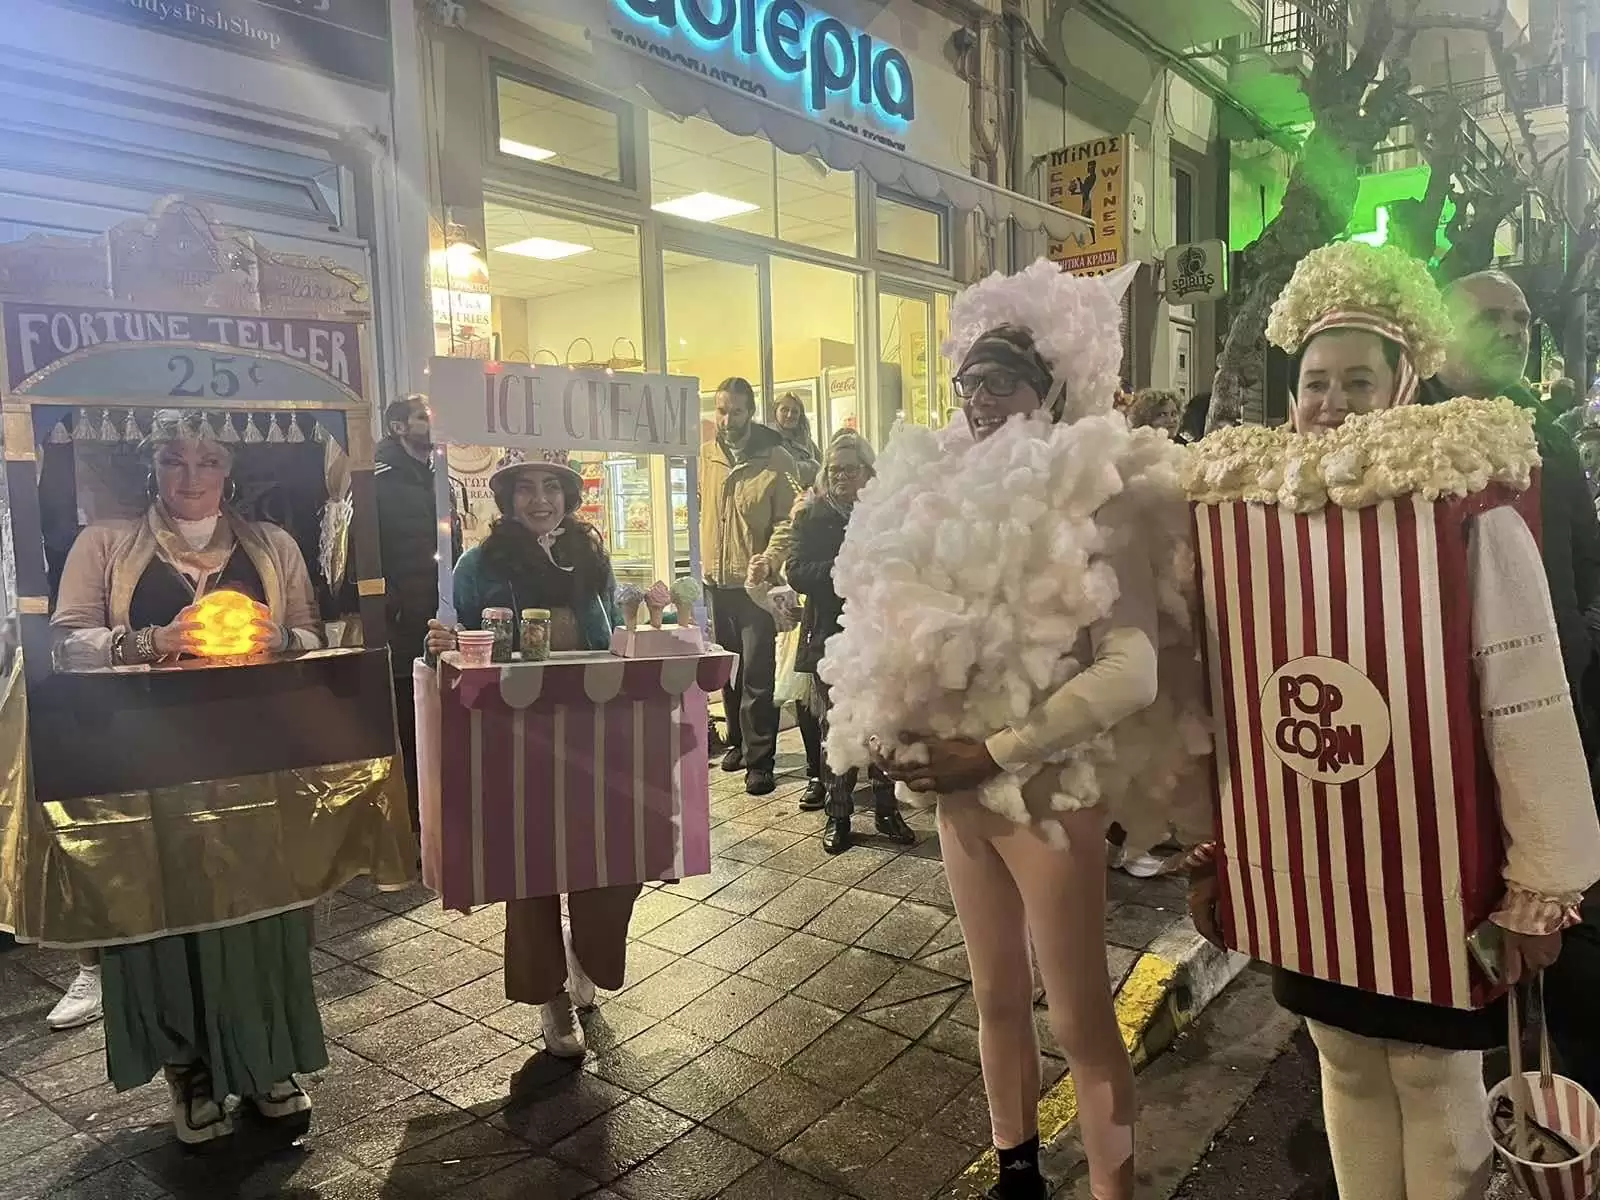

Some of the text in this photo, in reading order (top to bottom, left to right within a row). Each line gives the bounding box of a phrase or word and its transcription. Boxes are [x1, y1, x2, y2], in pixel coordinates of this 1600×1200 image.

[1101, 165, 1120, 237] WINES
[1087, 250, 1116, 267] ΚΡΑΣΙΑ
[1171, 273, 1215, 291] SPIRITS
[17, 311, 350, 385] FORTUNE TELLER
[485, 373, 688, 446] ICE CREAM
[1278, 673, 1344, 727] POP
[1275, 717, 1365, 774] CORN
